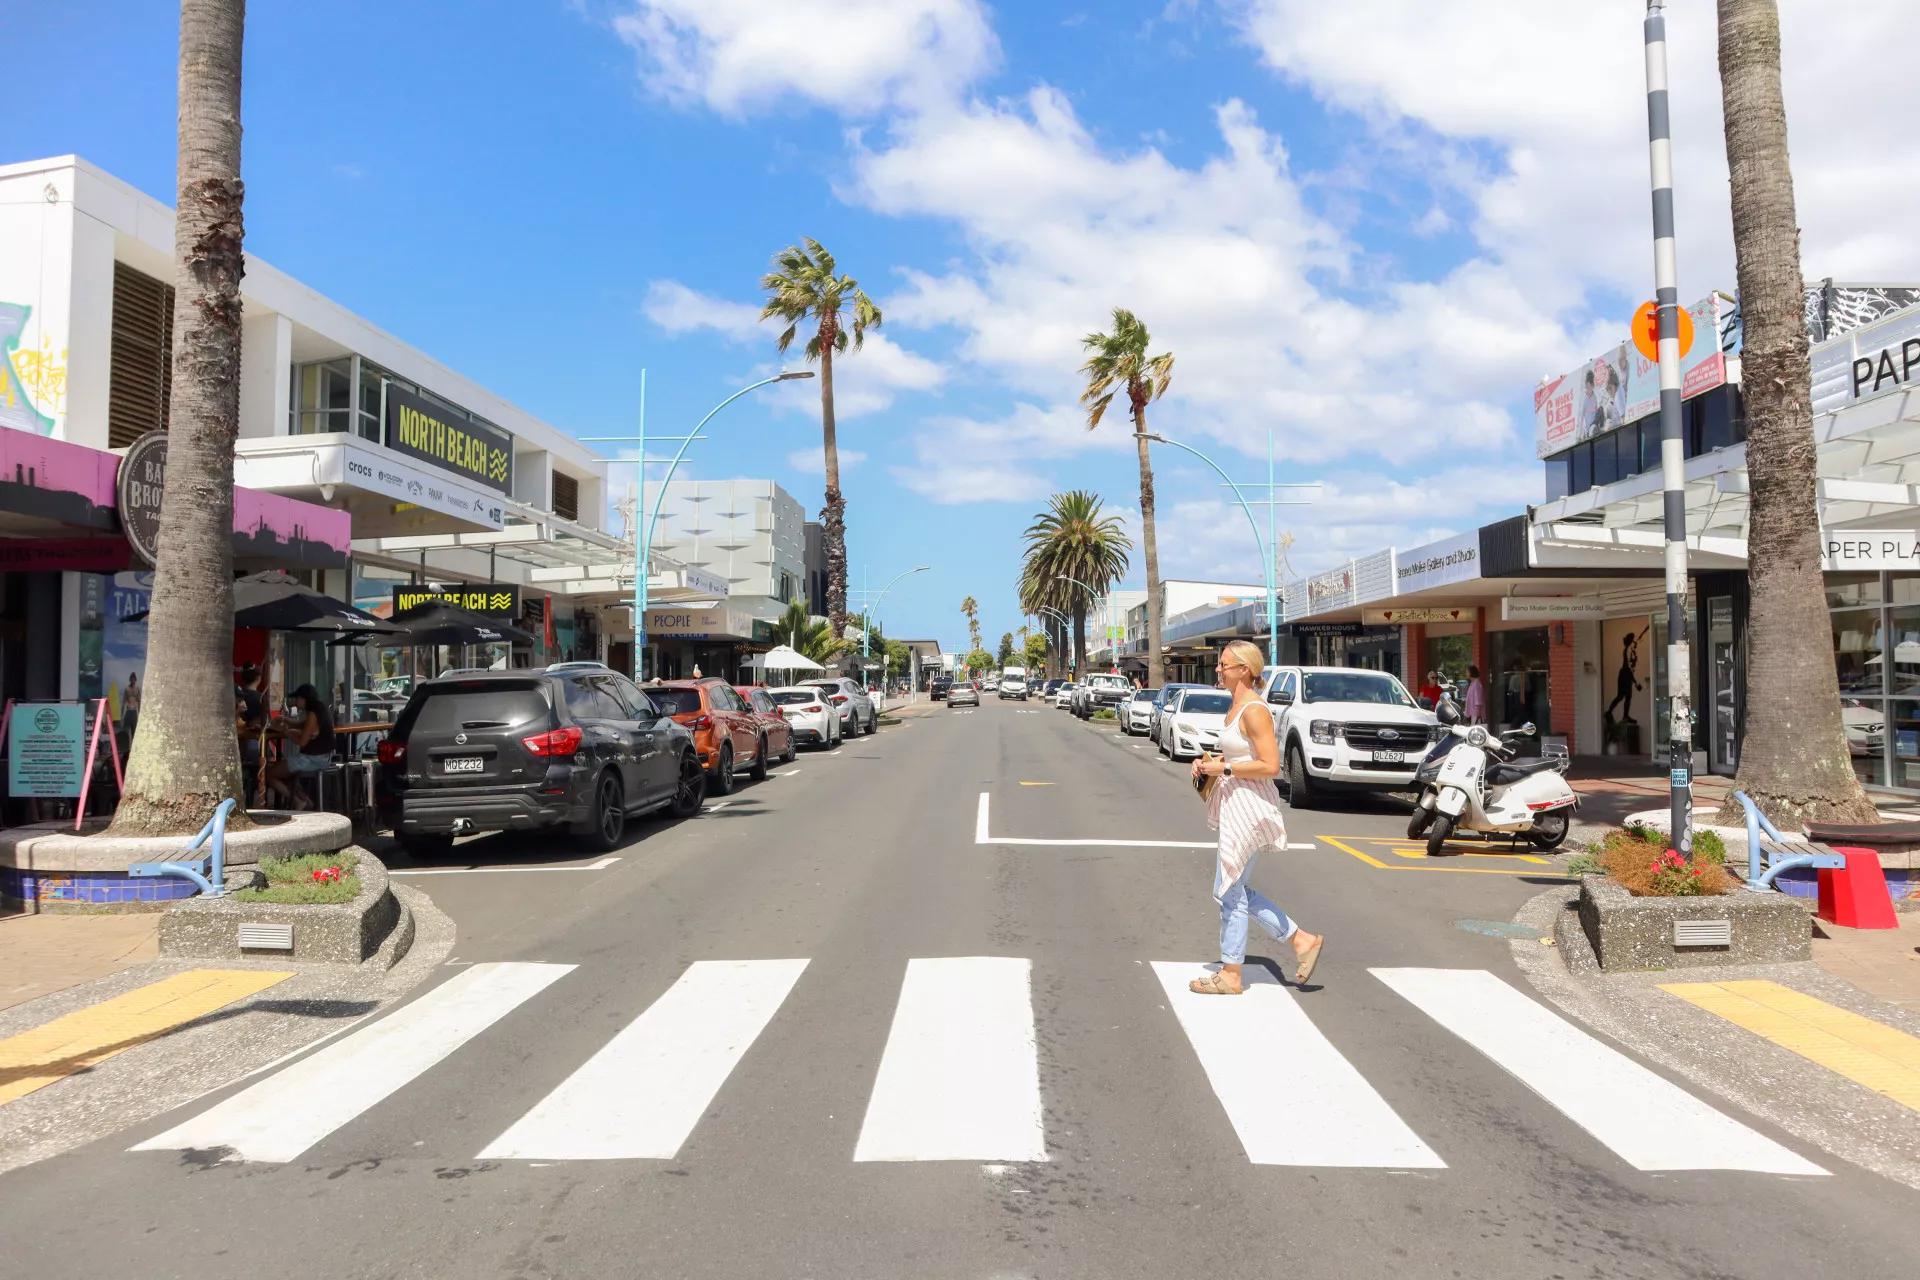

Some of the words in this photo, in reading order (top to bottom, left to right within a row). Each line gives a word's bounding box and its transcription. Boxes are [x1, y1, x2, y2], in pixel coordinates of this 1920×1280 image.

[1853, 338, 1920, 398] PAP
[399, 404, 446, 459] NORTH
[447, 426, 487, 476] BEACH
[348, 461, 373, 477] crocs
[1446, 551, 1457, 566] and
[1820, 541, 1872, 559] PER
[1882, 541, 1920, 559] PLA
[113, 591, 150, 616] TAI-
[654, 615, 691, 628] PEOPLE
